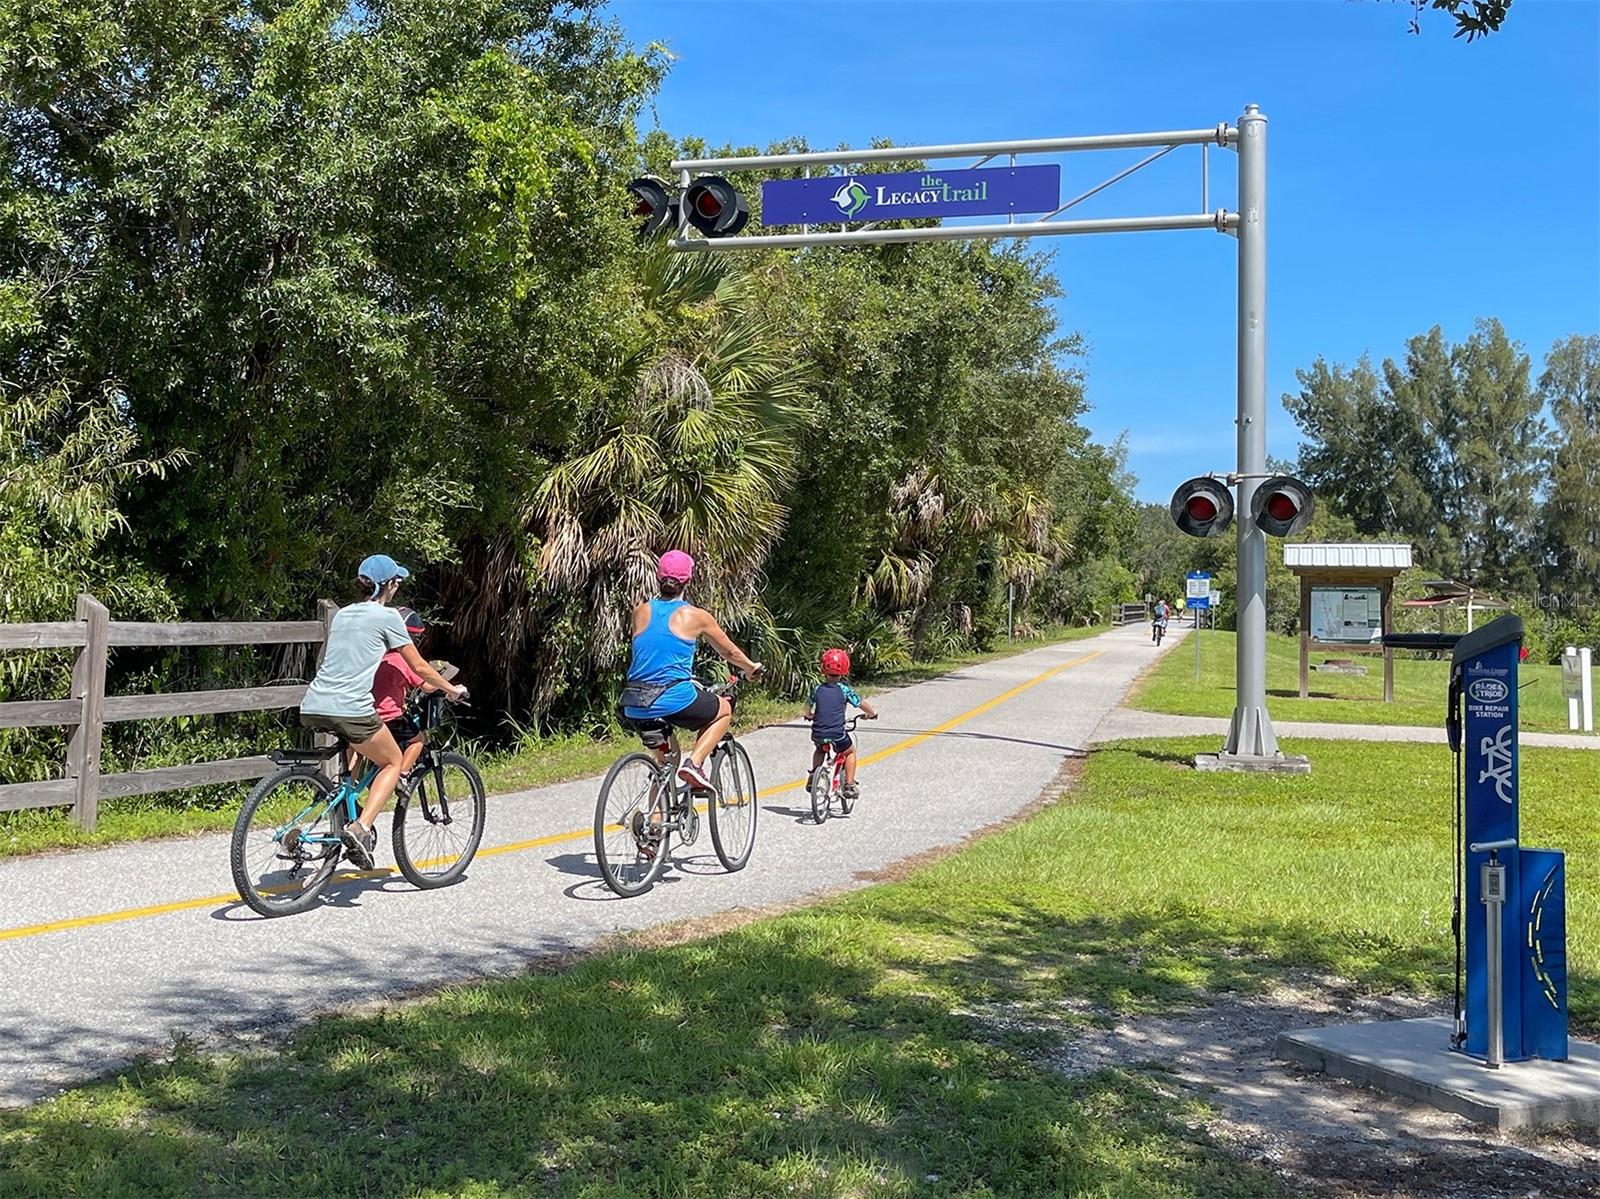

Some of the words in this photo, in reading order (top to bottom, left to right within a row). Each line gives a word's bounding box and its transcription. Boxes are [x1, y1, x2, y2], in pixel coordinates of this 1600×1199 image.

[920, 175, 943, 188] the
[875, 186, 942, 207] LEGACY
[941, 181, 988, 203] trail
[1485, 704, 1509, 712] REPAIR
